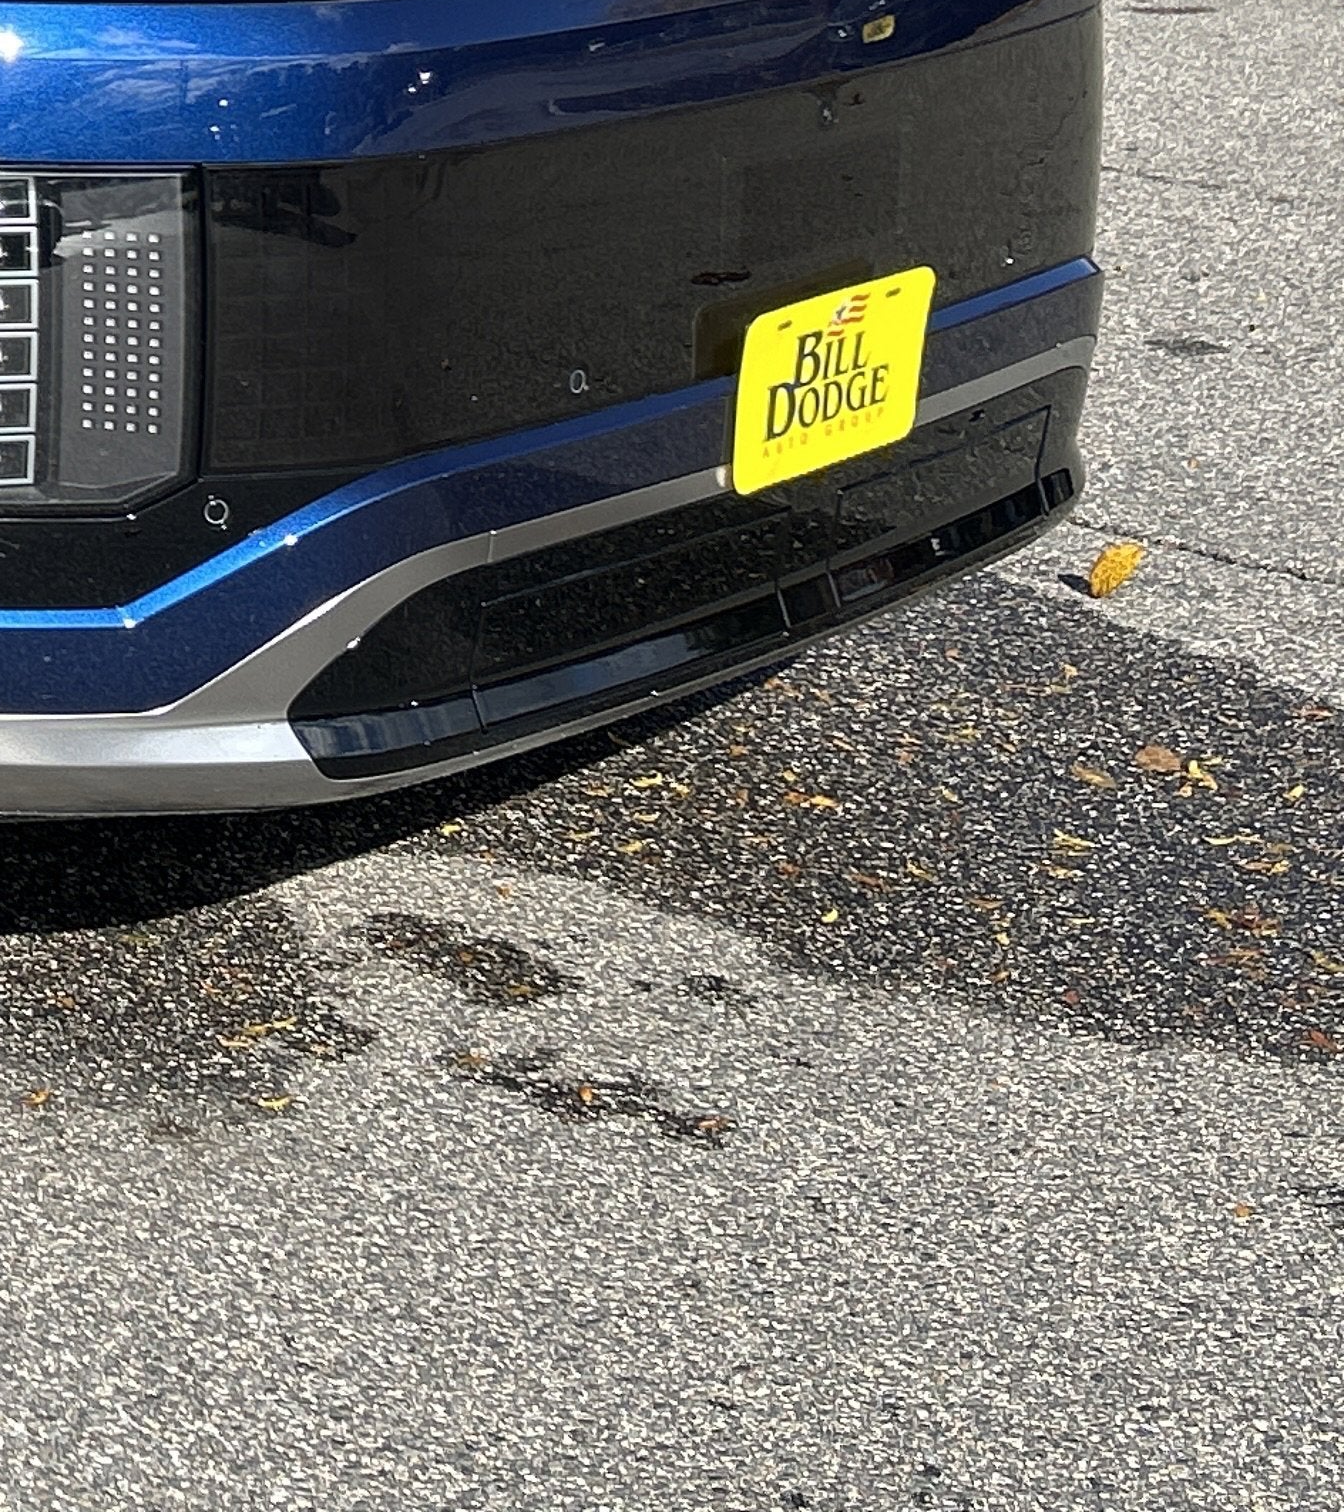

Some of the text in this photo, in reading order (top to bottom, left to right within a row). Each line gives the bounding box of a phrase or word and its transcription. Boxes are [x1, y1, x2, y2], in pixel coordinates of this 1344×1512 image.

[794, 330, 871, 388] BILL
[763, 364, 889, 442] DODGE
[762, 407, 884, 459] AUTO GROUP
